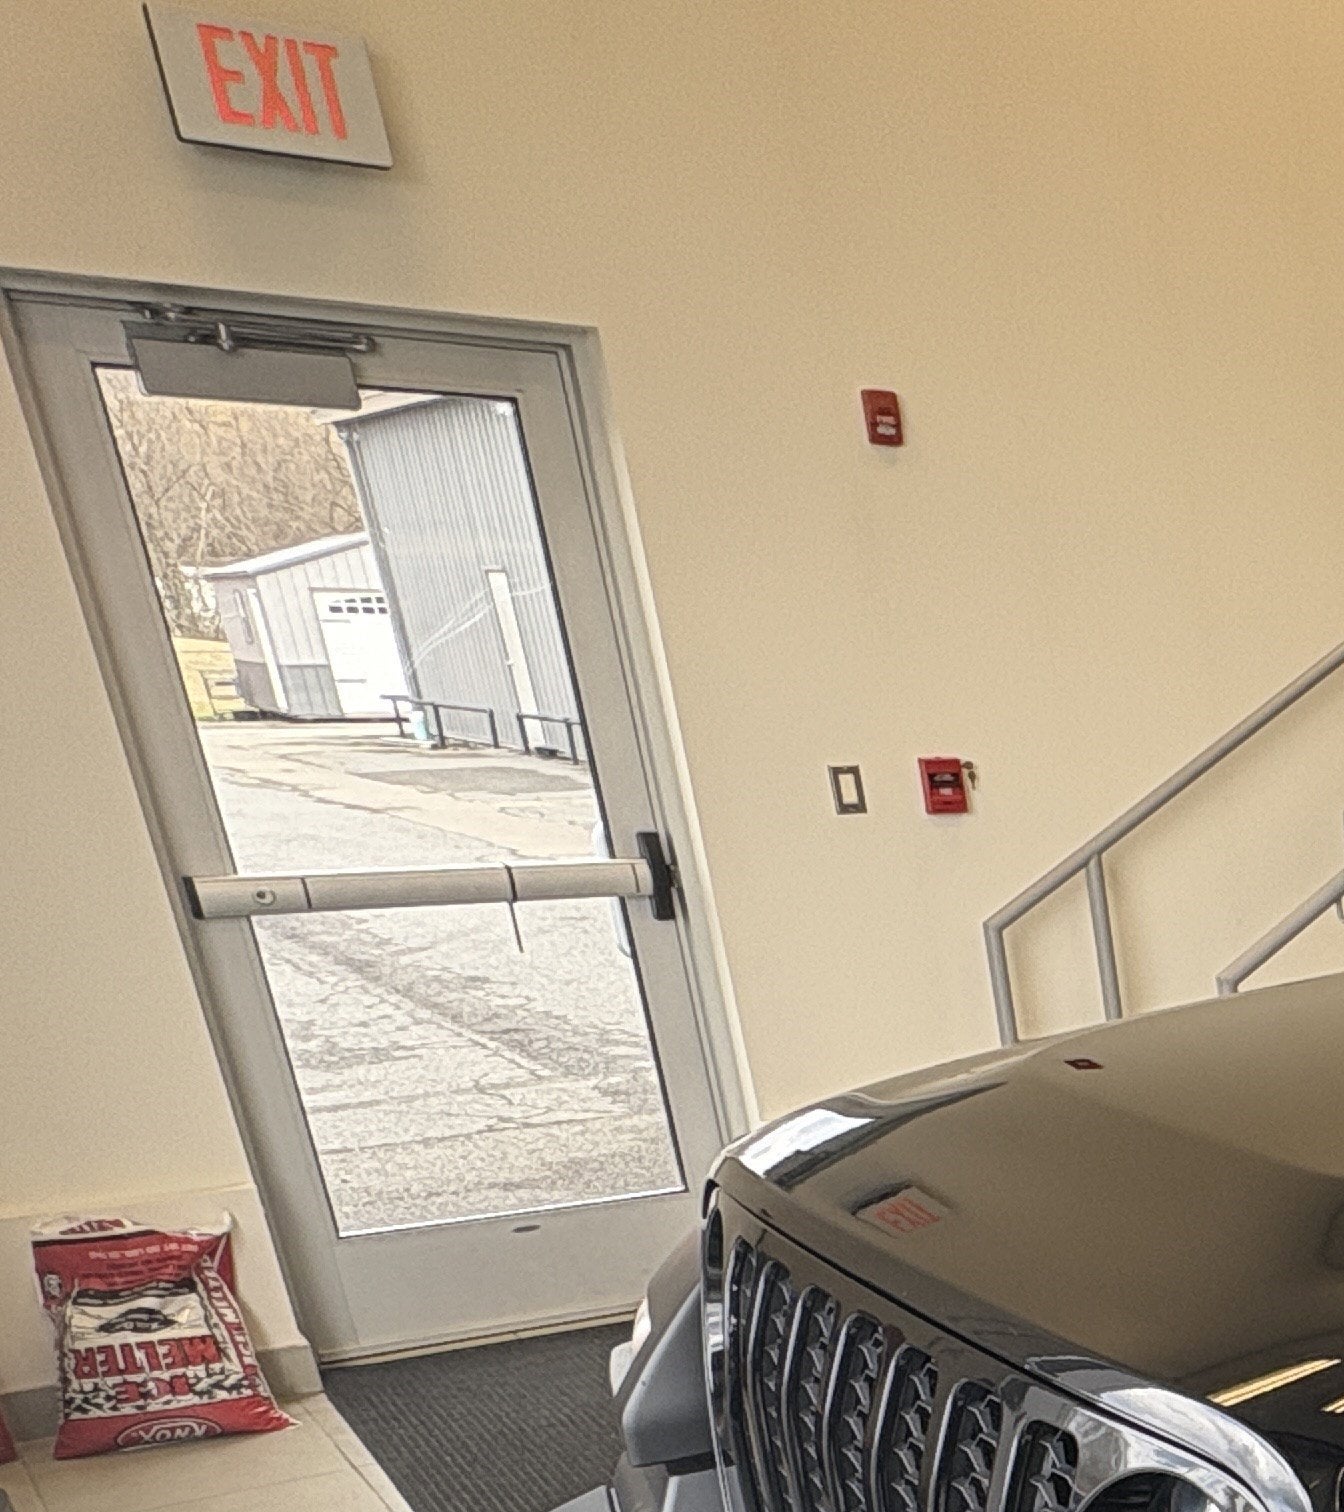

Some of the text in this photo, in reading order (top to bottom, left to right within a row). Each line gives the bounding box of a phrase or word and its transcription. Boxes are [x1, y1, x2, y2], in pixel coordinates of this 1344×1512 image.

[197, 23, 348, 141] EXIT
[73, 1335, 222, 1380] MELTER
[115, 1375, 190, 1403] ICE
